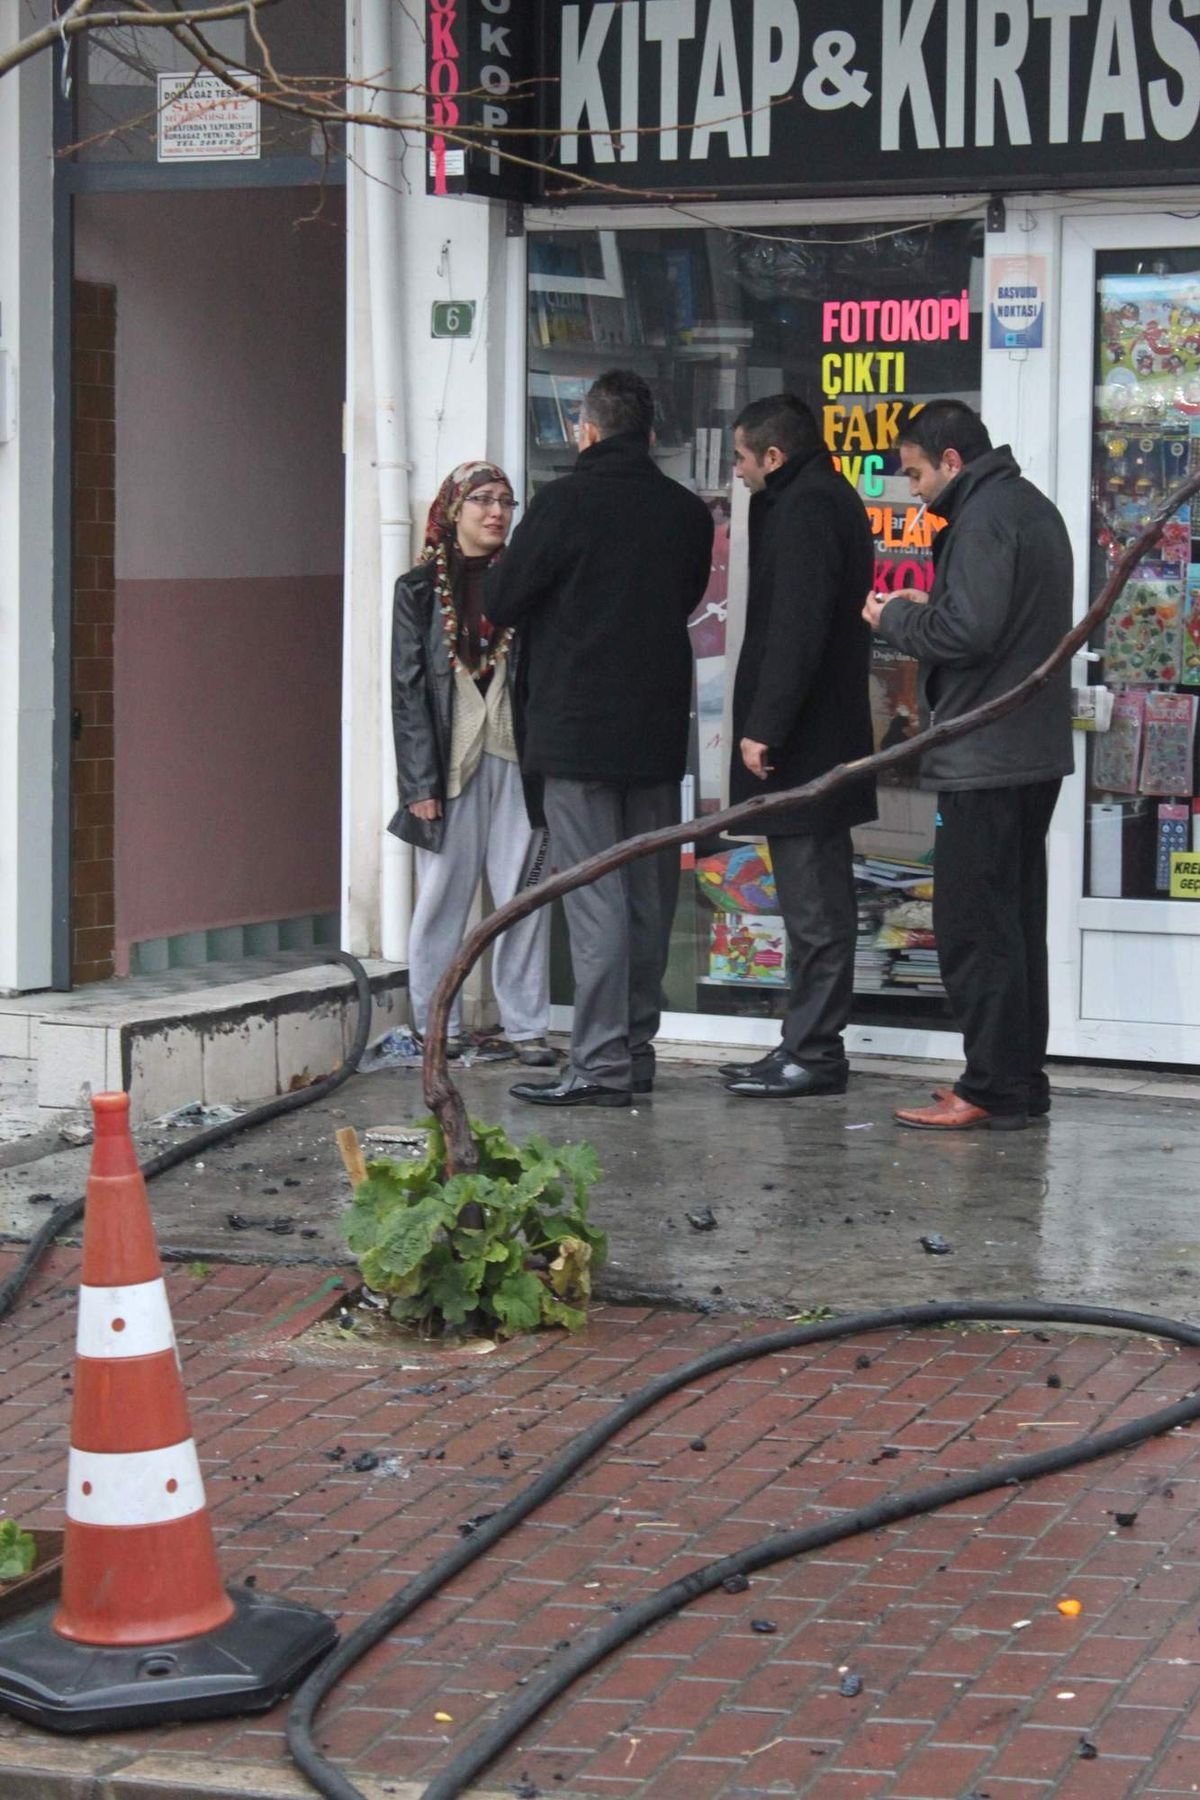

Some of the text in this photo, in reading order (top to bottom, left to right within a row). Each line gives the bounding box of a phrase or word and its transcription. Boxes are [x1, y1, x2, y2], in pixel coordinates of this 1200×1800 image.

[802, 30, 872, 110] &
[164, 89, 213, 100] DOALGAZ
[430, 0, 460, 195] KOPI
[447, 306, 460, 331] 6
[822, 289, 969, 343] FOTOKOPİ
[997, 305, 1037, 317] NOKTASI
[822, 352, 905, 400] ÇIKTI
[822, 402, 925, 452] FAK
[832, 455, 884, 497] VC
[1174, 861, 1200, 875] KRE
